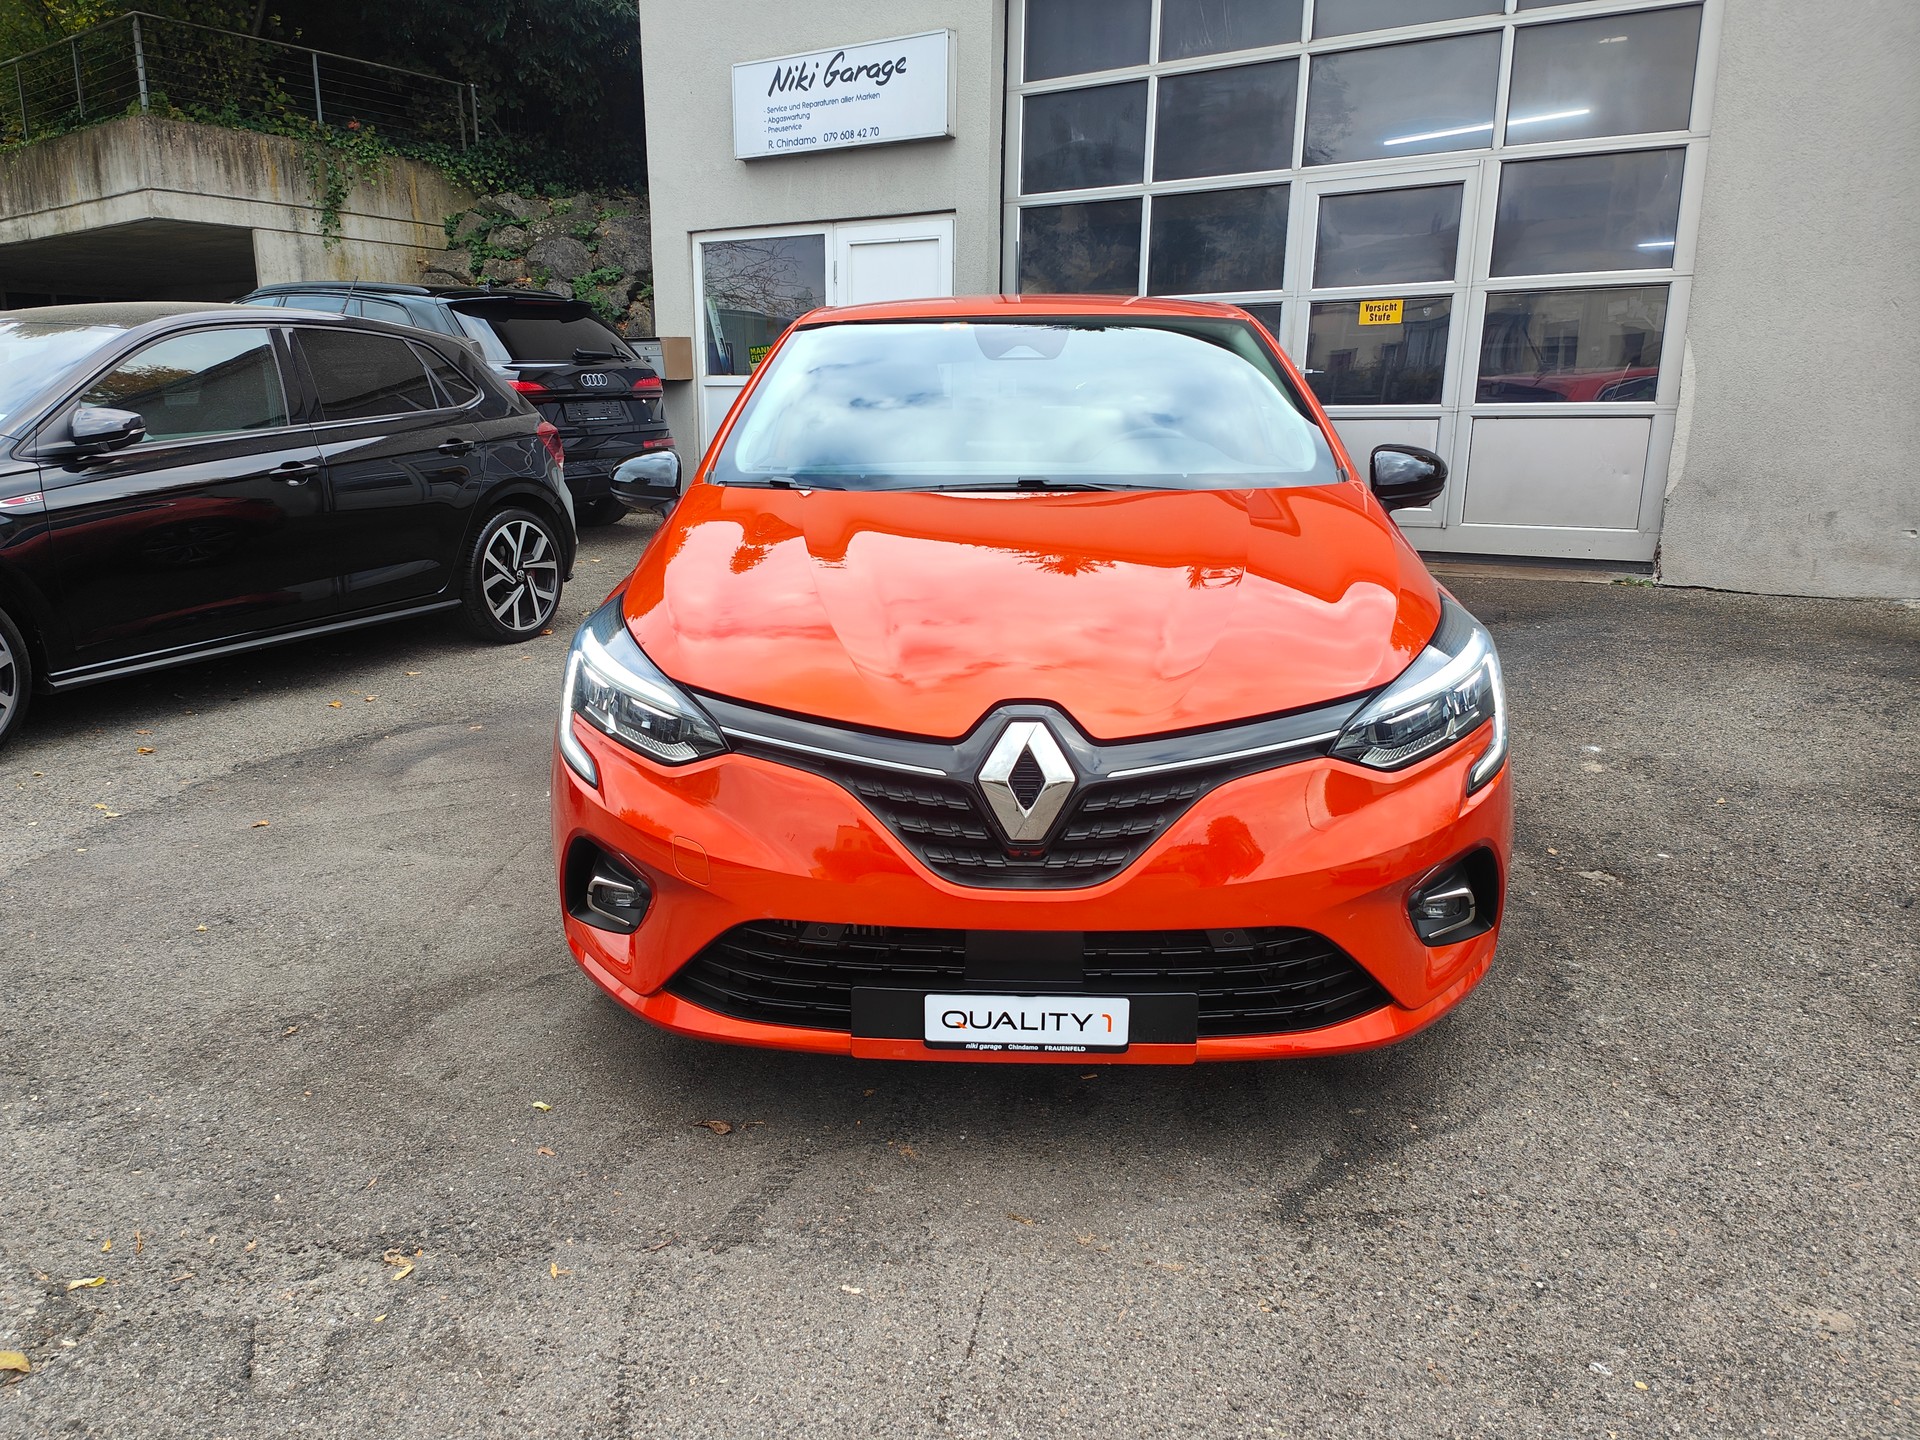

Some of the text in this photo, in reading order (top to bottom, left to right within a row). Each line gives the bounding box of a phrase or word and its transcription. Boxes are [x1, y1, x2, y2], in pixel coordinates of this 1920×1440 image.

[768, 51, 907, 97] Niki Garage
[767, 92, 880, 115] Service und Reparaturen aller Marken
[768, 113, 811, 124] Abgaswartung
[768, 123, 802, 133] Pneuservice
[777, 136, 817, 148] Chindamo
[823, 132, 838, 142] 079
[840, 130, 854, 140] 608
[857, 128, 867, 138] 42
[869, 126, 880, 136] 70
[1366, 303, 1397, 312] Vorsicht
[1369, 313, 1391, 321] Stufe
[941, 1010, 1112, 1033] QUALITY 1
